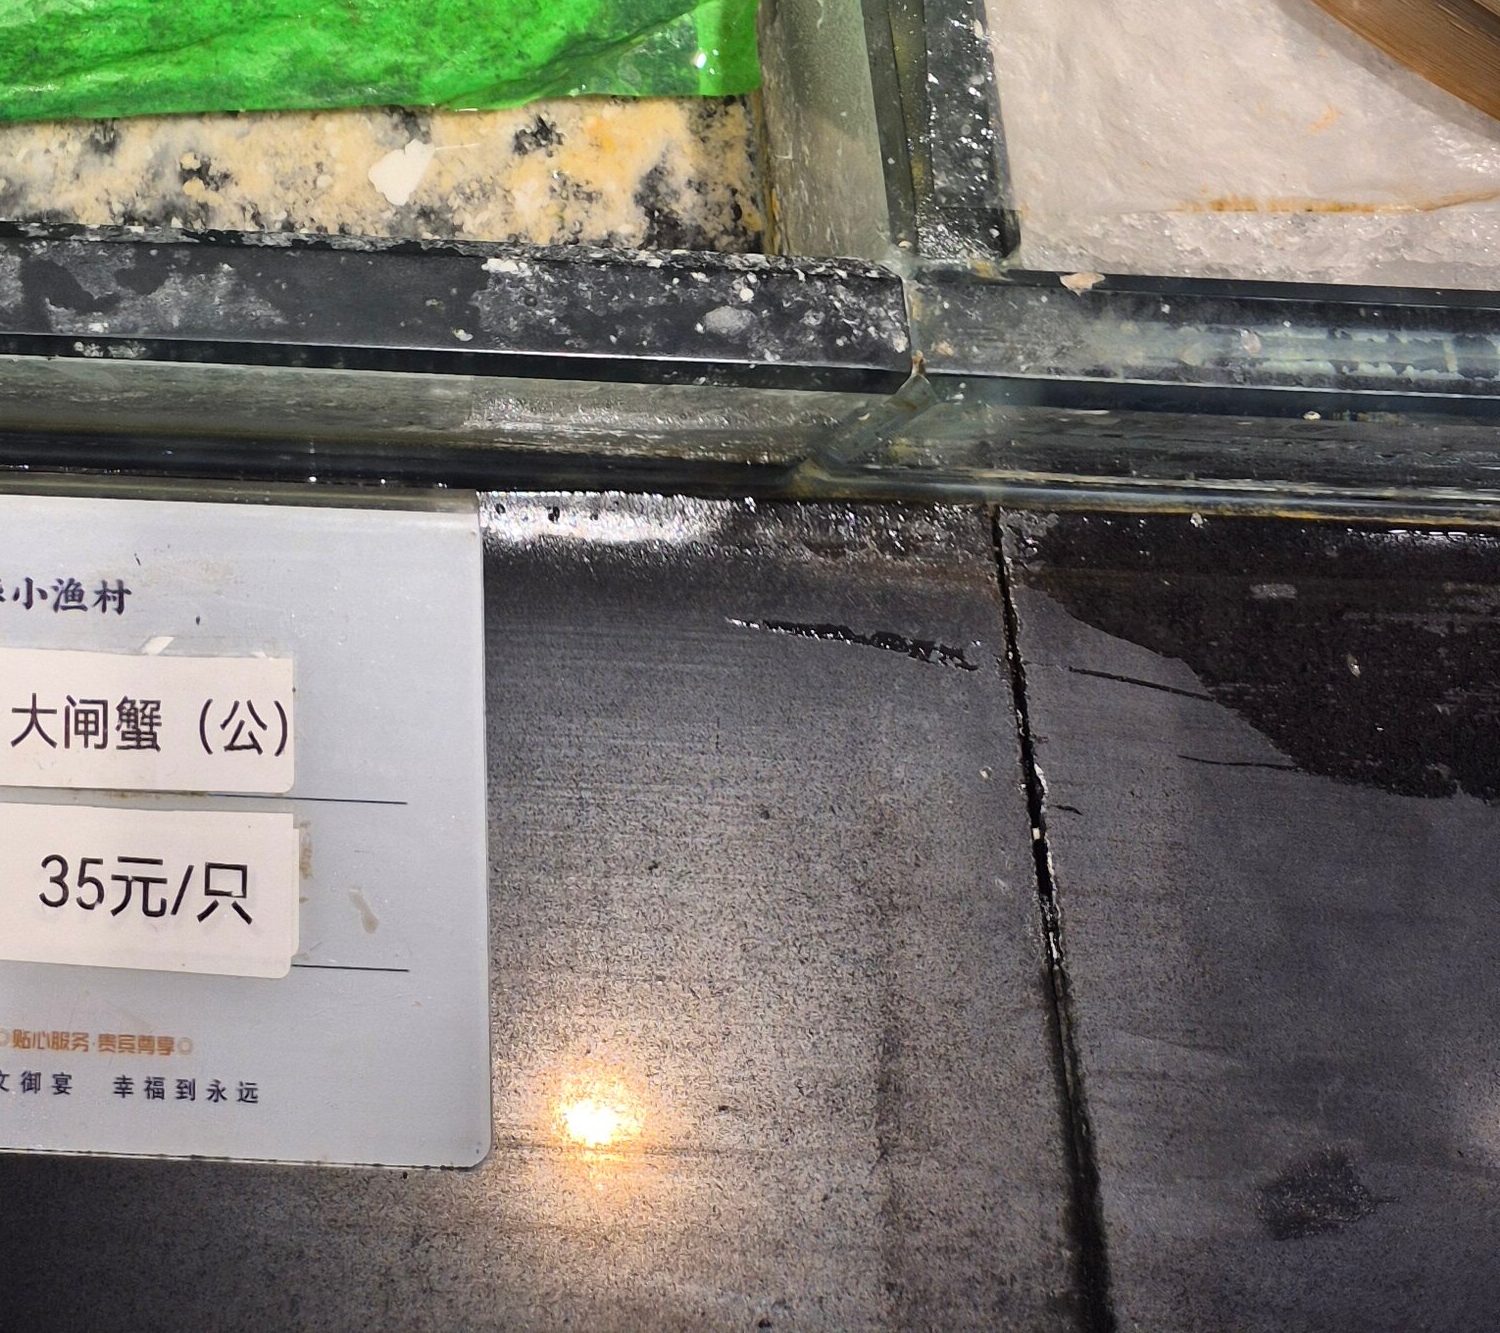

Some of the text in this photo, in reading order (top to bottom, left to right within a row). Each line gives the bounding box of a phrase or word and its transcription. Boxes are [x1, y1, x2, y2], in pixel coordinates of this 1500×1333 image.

[40, 854, 253, 925] 35元/只
[113, 1075, 259, 1104] 幸福到永远
